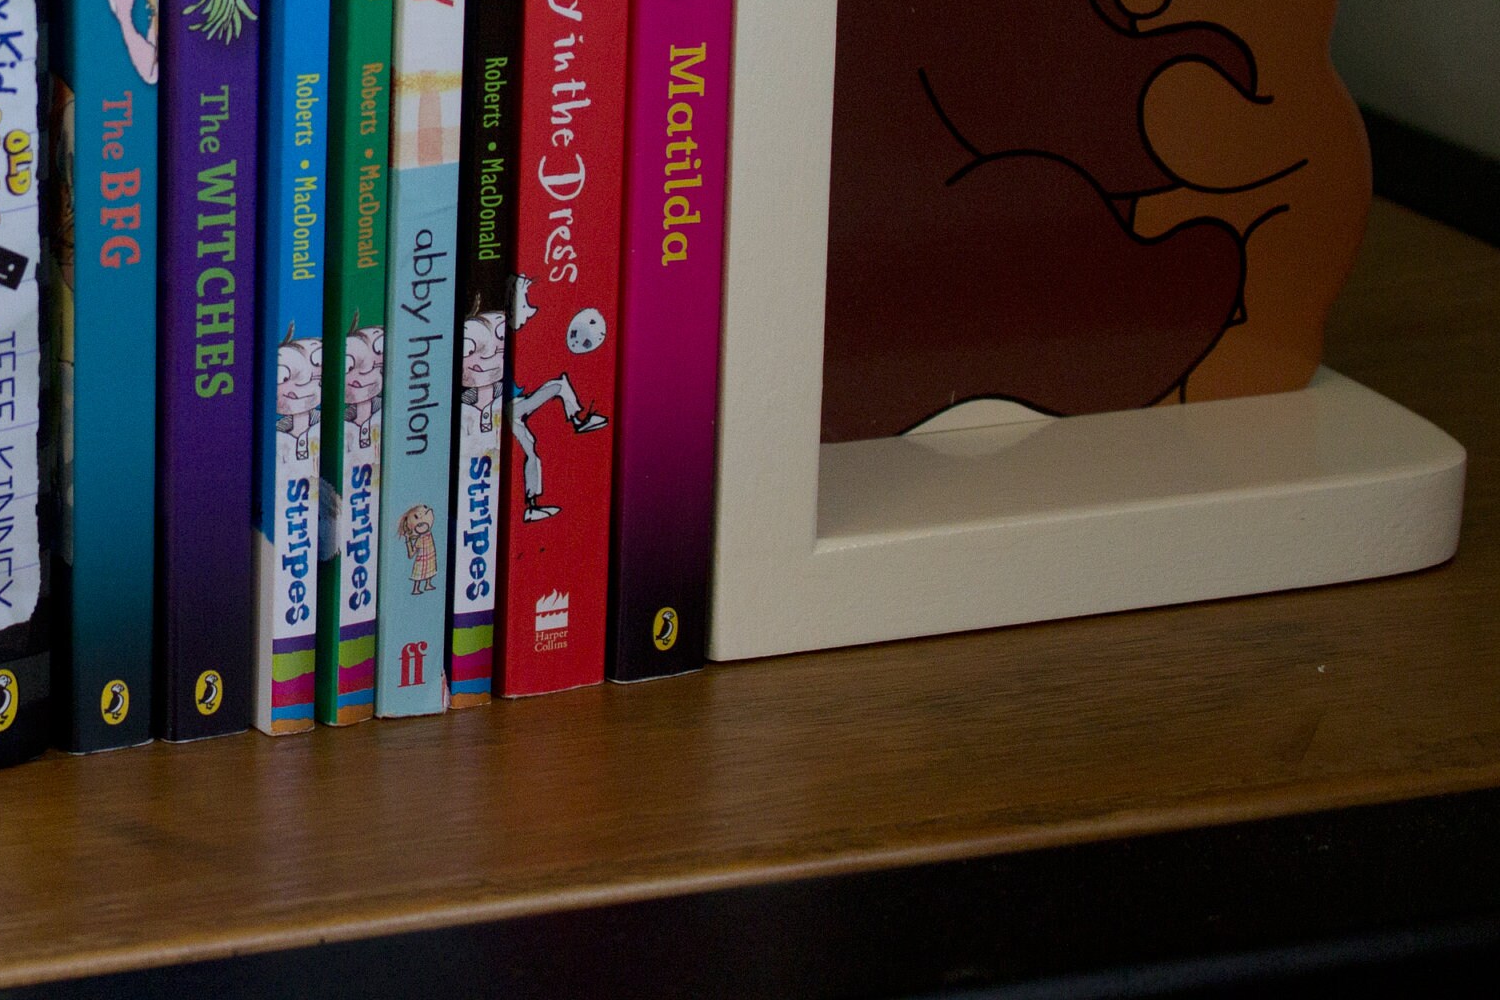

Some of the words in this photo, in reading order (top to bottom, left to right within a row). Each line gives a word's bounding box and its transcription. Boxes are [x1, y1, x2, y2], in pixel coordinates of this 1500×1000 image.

[553, 33, 584, 72] in
[102, 90, 133, 160] The
[200, 84, 230, 153] The
[295, 73, 320, 147] Roberts
[360, 62, 383, 135] Roberts
[483, 56, 508, 129] Roberts
[550, 78, 591, 147] the
[3, 129, 33, 196] OLD
[661, 42, 707, 267] Matilda
[100, 167, 141, 269] BFG
[292, 176, 318, 281] MacDonald
[357, 164, 380, 269] MacDonald
[478, 157, 504, 261] MacDonald
[538, 153, 586, 283] Dress
[195, 159, 237, 398] WITCHES
[401, 228, 448, 324] abby
[405, 334, 444, 456] hanlon
[534, 639, 568, 653] Collins
[535, 630, 568, 643] Harper
